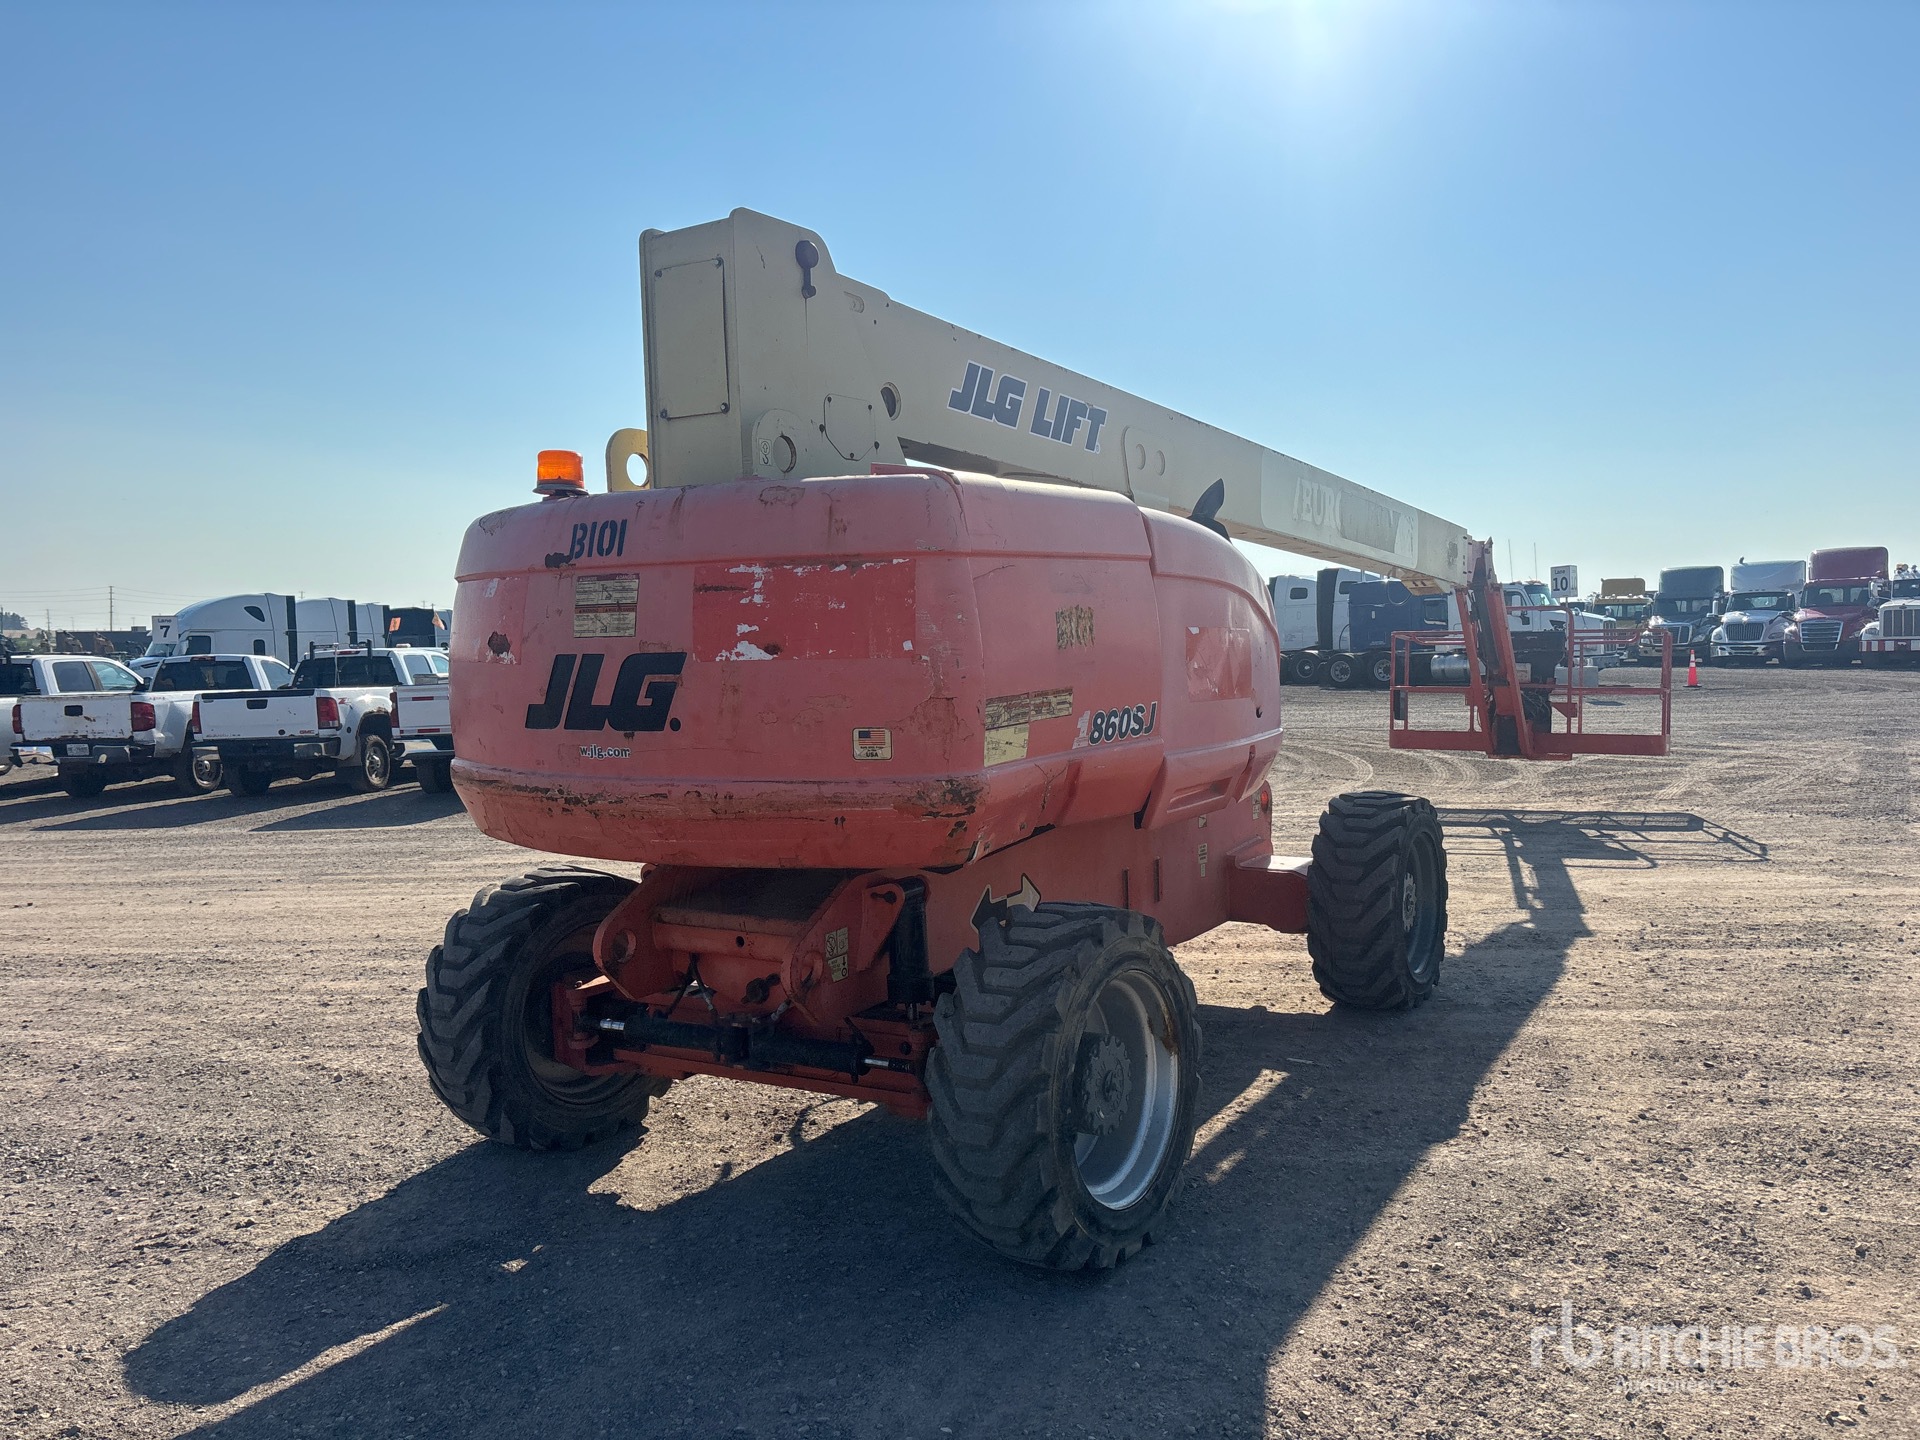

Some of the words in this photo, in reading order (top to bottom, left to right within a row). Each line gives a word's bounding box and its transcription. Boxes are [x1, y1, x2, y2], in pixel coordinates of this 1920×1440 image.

[947, 360, 1028, 430] JLG
[1029, 386, 1108, 453] LIFT
[1553, 577, 1568, 591] 10
[160, 625, 170, 638] 7
